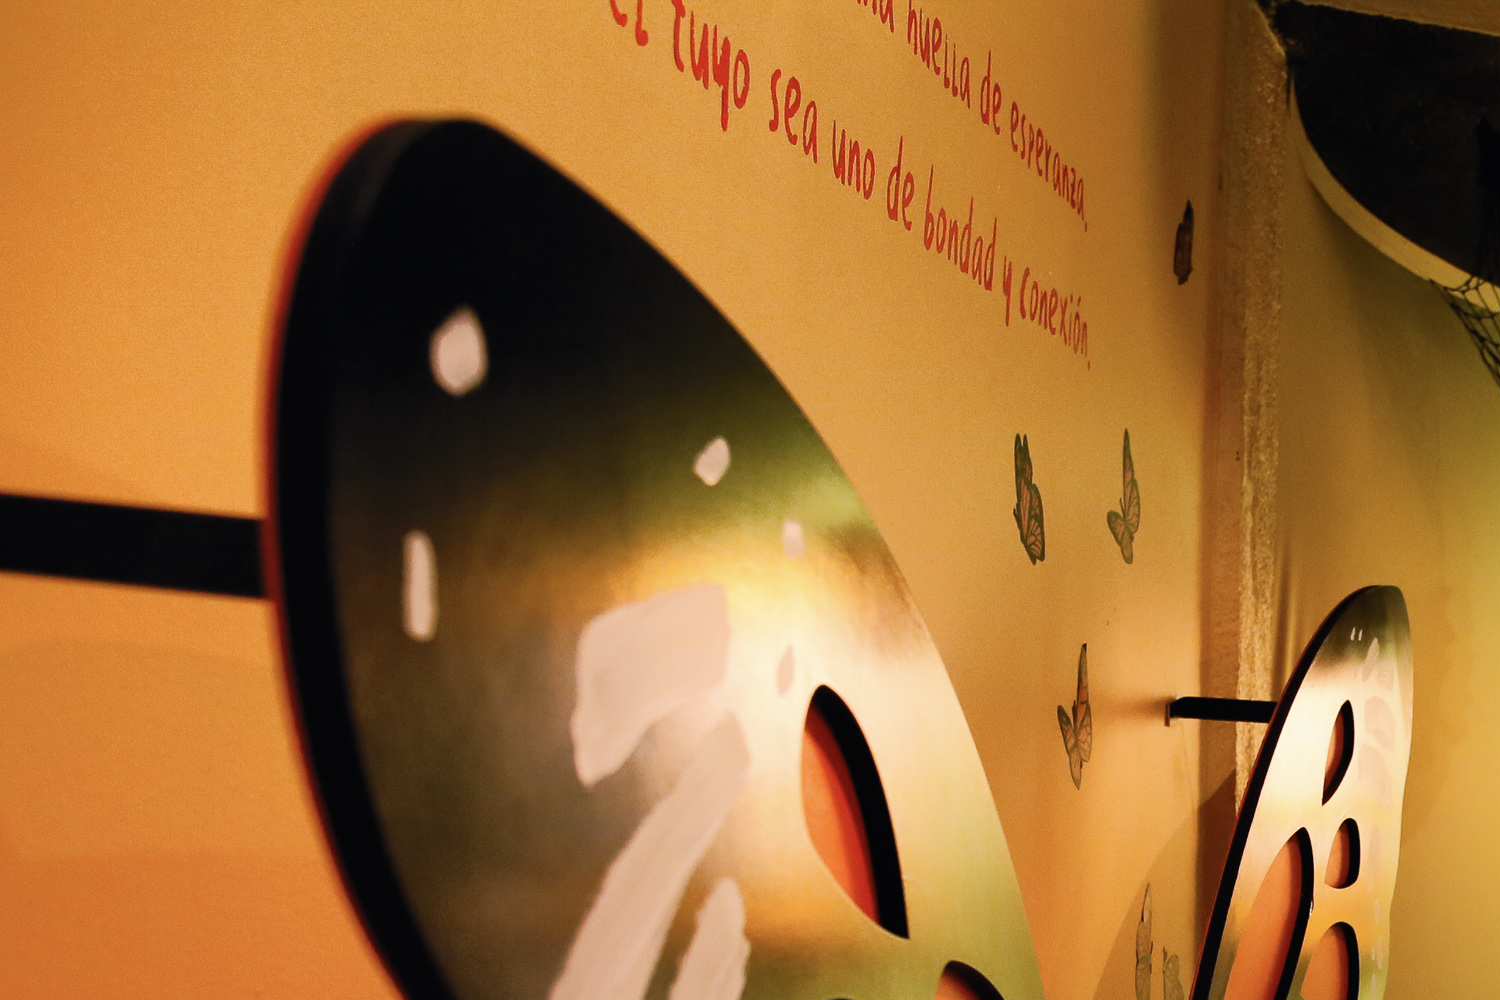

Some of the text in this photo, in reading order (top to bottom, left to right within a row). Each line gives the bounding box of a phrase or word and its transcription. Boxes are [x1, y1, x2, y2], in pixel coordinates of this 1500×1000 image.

[670, 0, 751, 132] tuyo
[768, 68, 819, 164] sea
[832, 119, 876, 200] uno
[886, 135, 915, 231] de
[923, 164, 998, 291] bondad
[1002, 255, 1013, 327] y
[907, 0, 972, 109] huella
[980, 49, 1003, 136] de
